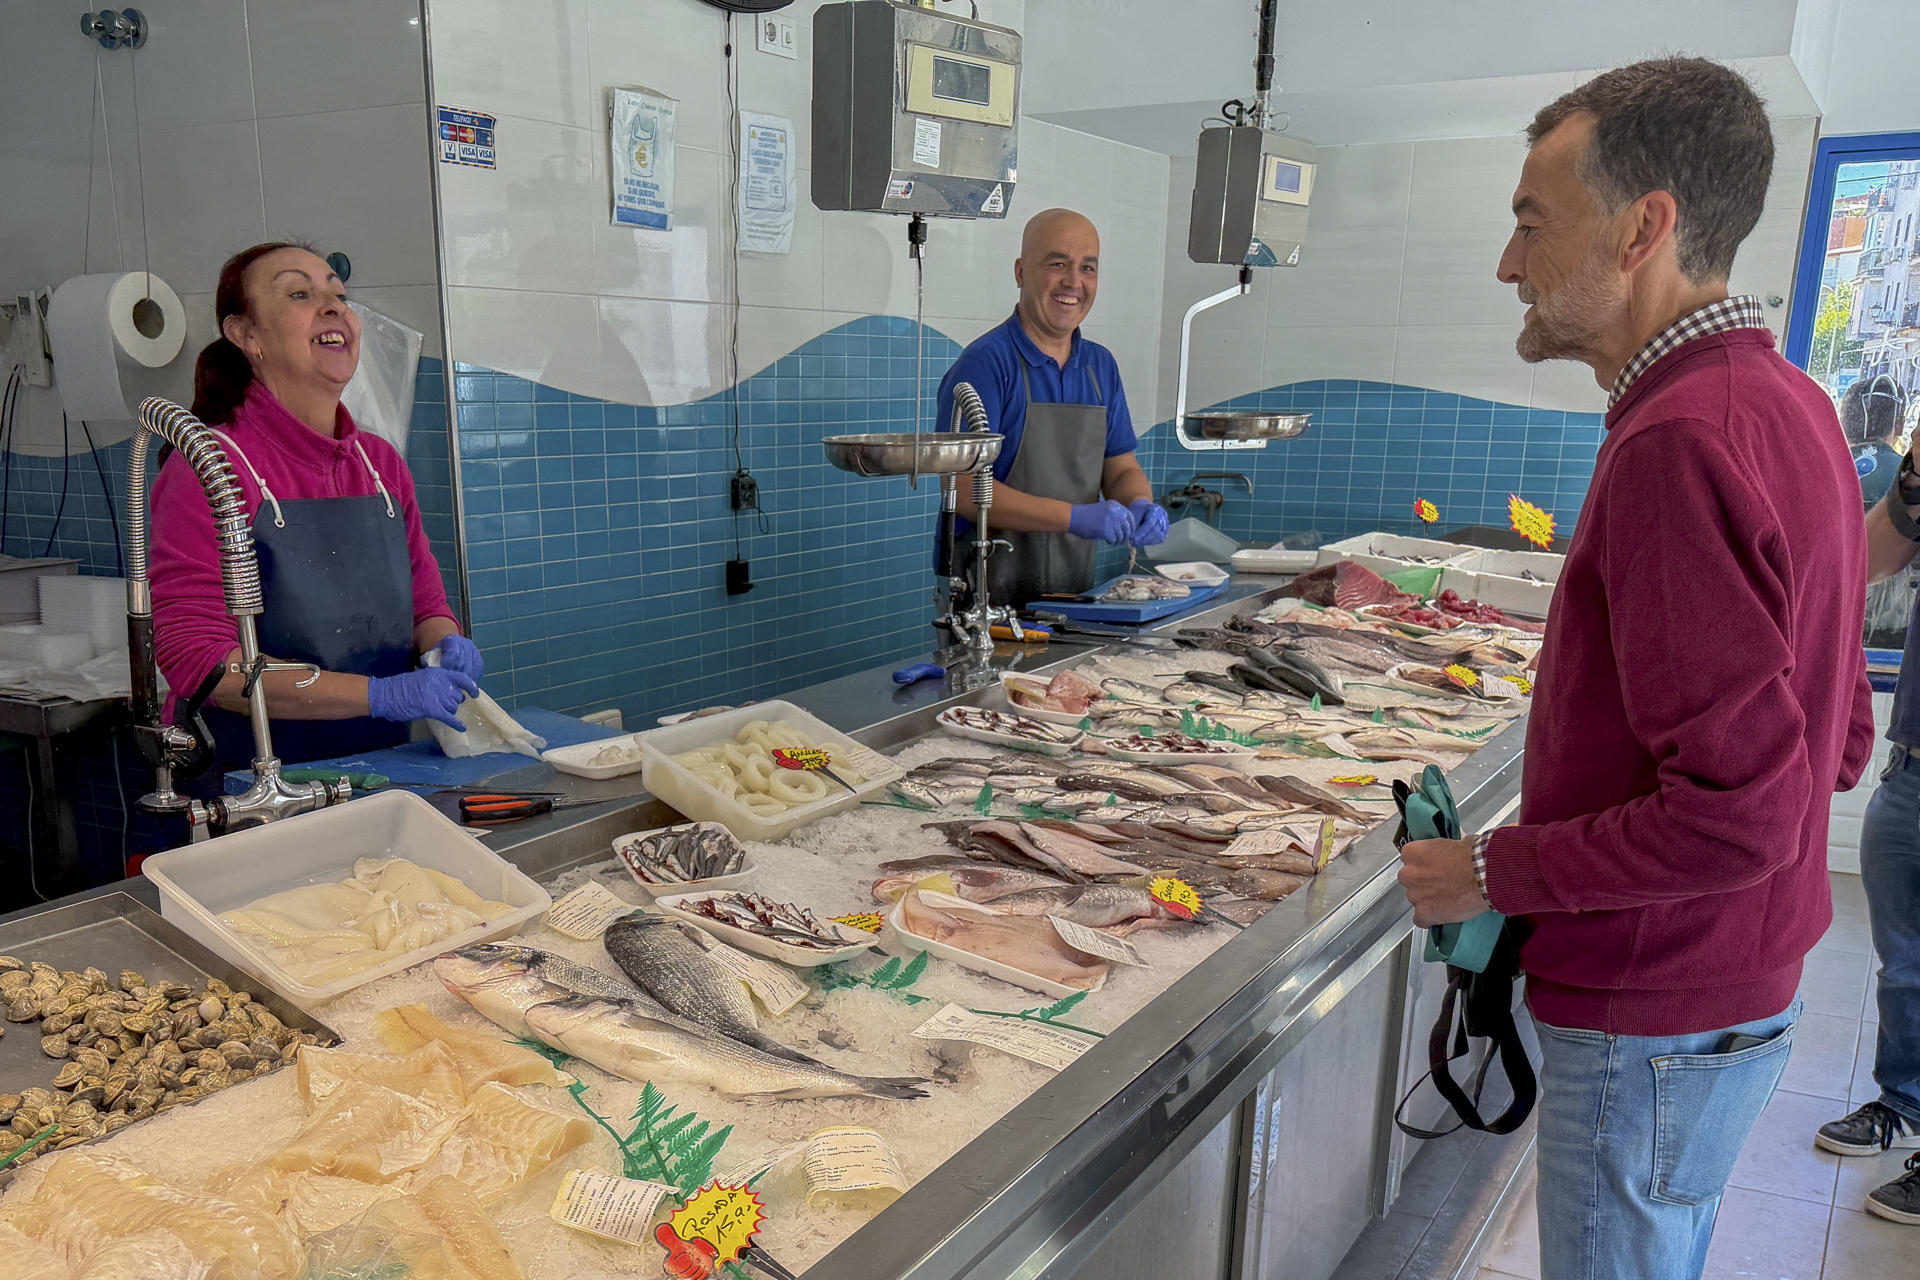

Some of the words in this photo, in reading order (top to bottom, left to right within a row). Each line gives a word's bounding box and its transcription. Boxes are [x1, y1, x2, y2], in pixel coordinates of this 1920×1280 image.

[462, 146, 476, 156] VISA
[478, 149, 493, 158] VISA
[682, 1192, 738, 1238] ROSADA
